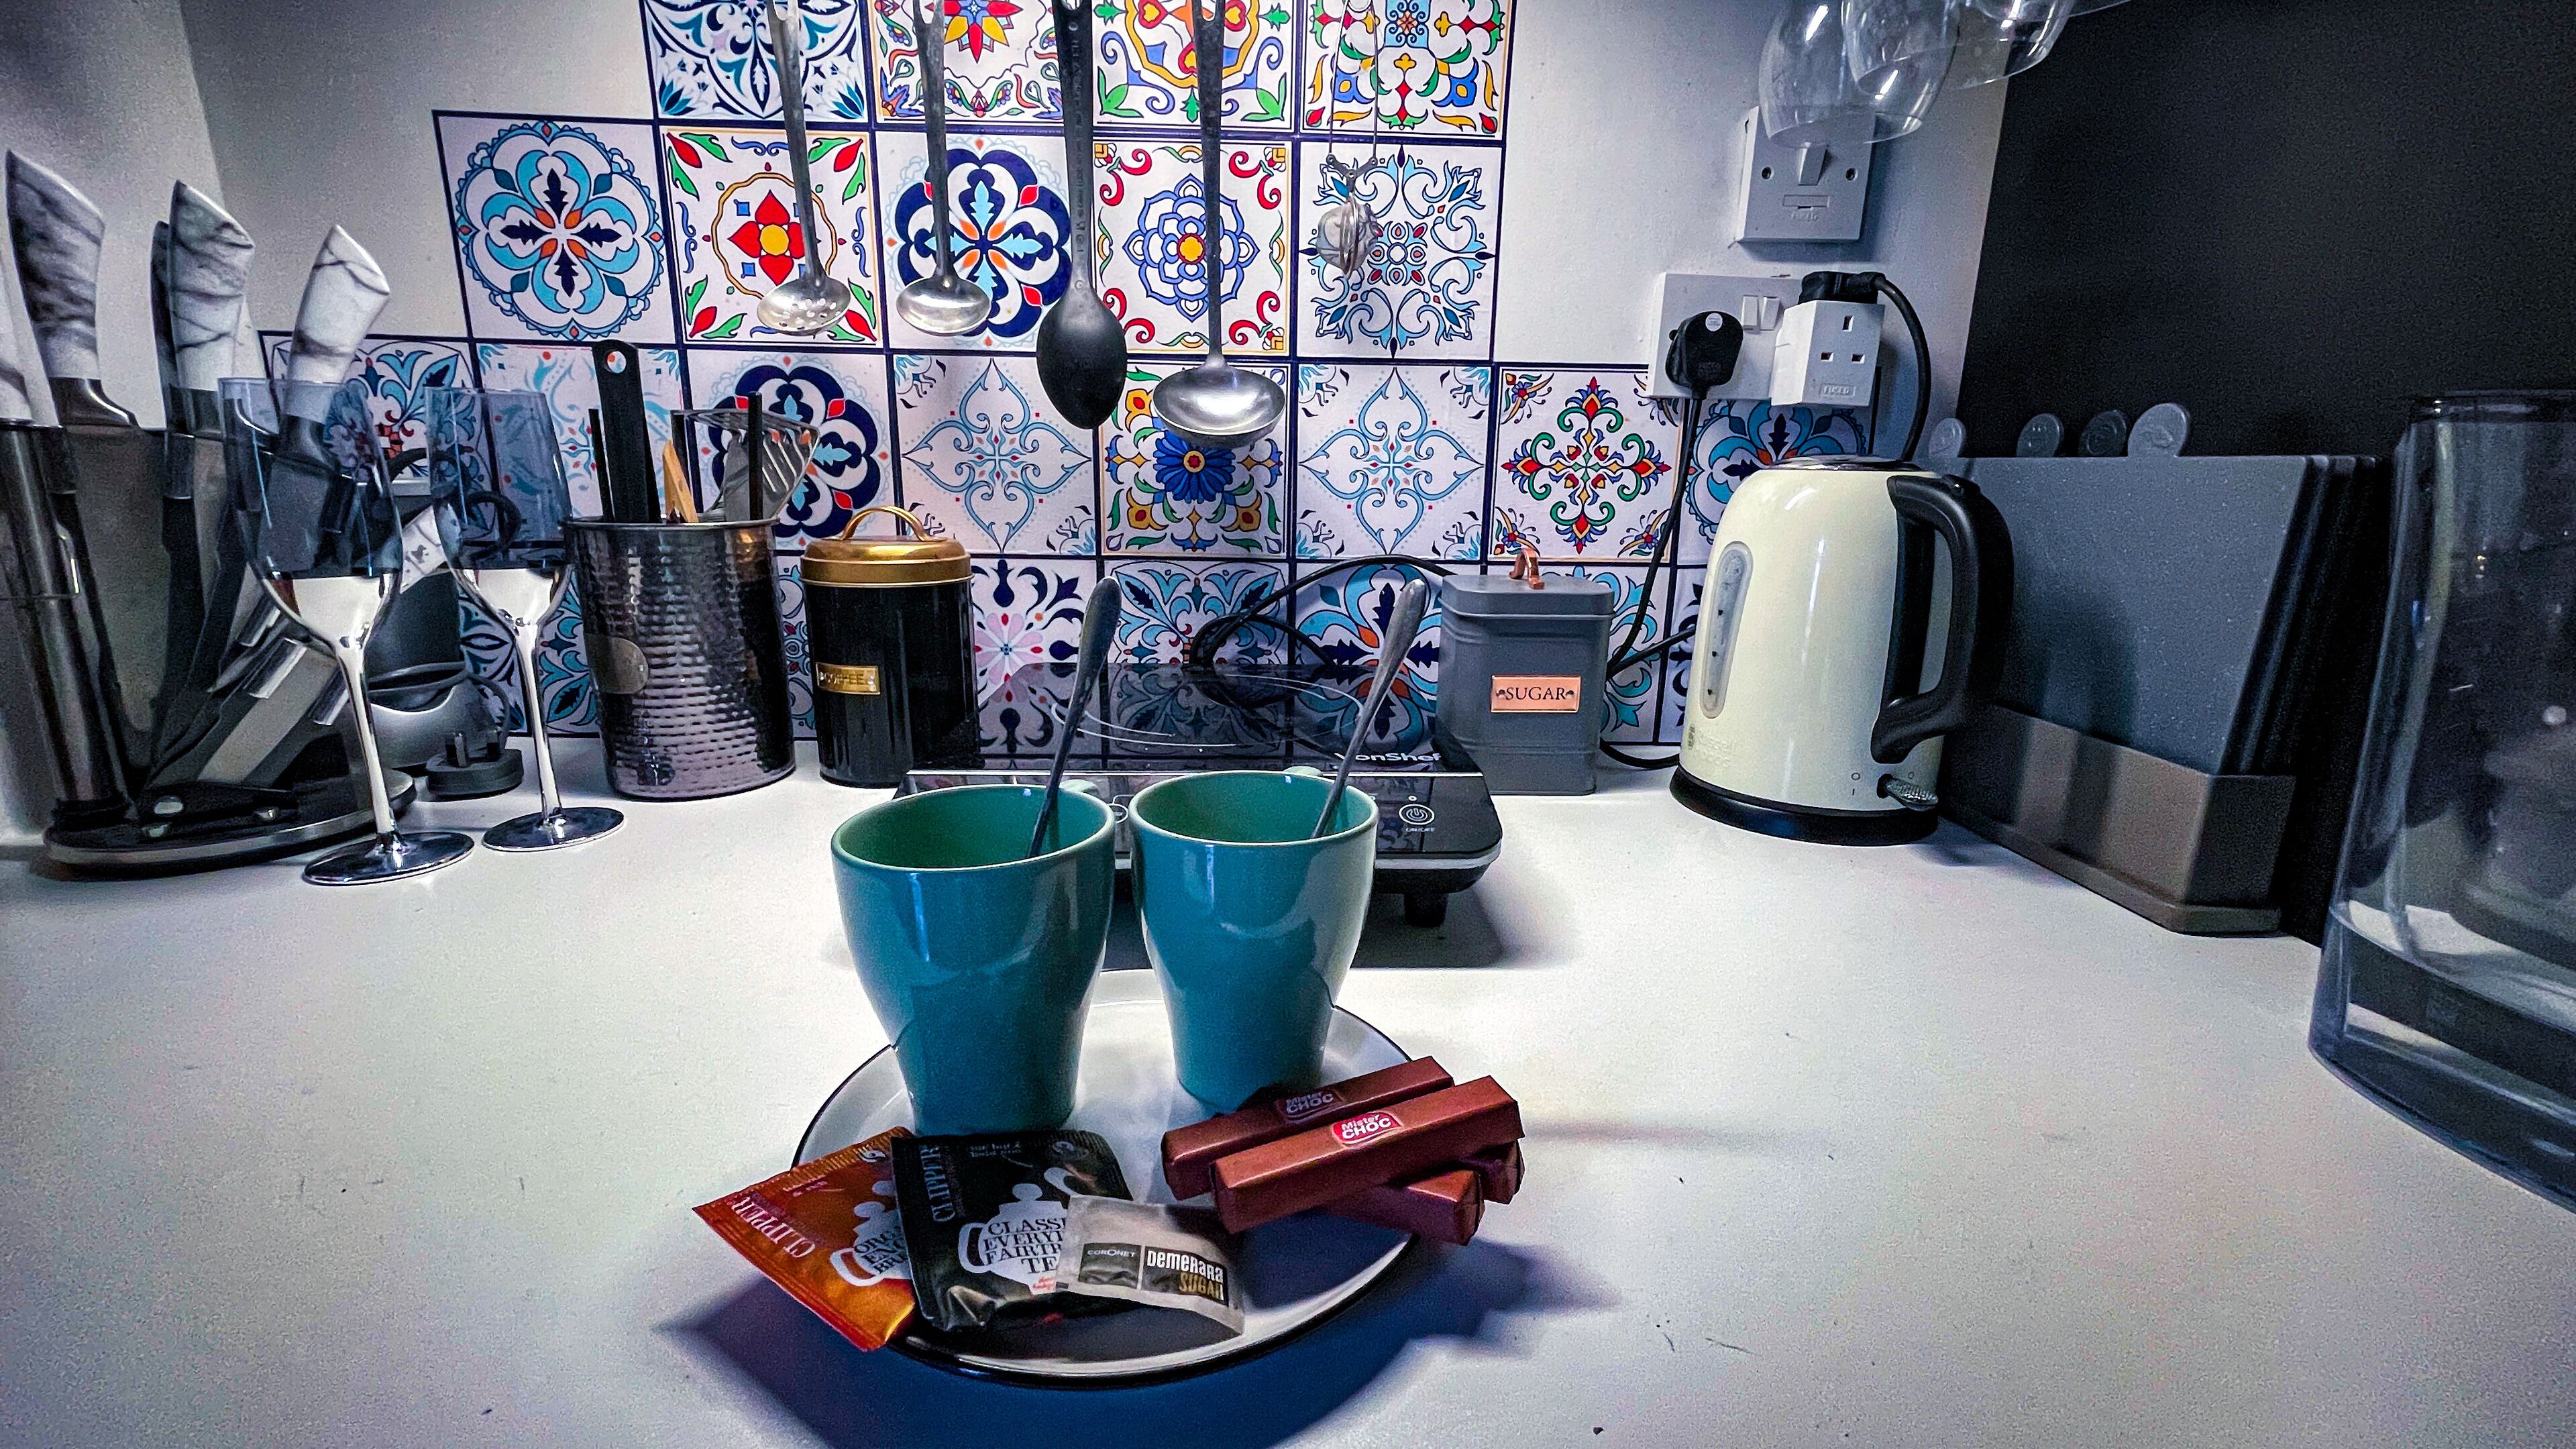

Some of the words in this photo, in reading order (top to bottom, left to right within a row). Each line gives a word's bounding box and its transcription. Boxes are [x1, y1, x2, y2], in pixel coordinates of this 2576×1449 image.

[1505, 686, 1566, 700] SUGAR
[1287, 1093, 1334, 1114] CHOC
[1342, 1114, 1380, 1130] Mister
[1342, 1118, 1391, 1139] CHOC
[920, 1144, 955, 1221] CLIPPER
[1087, 1249, 1135, 1257] CORONET
[1179, 1272, 1224, 1301] SUGAR
